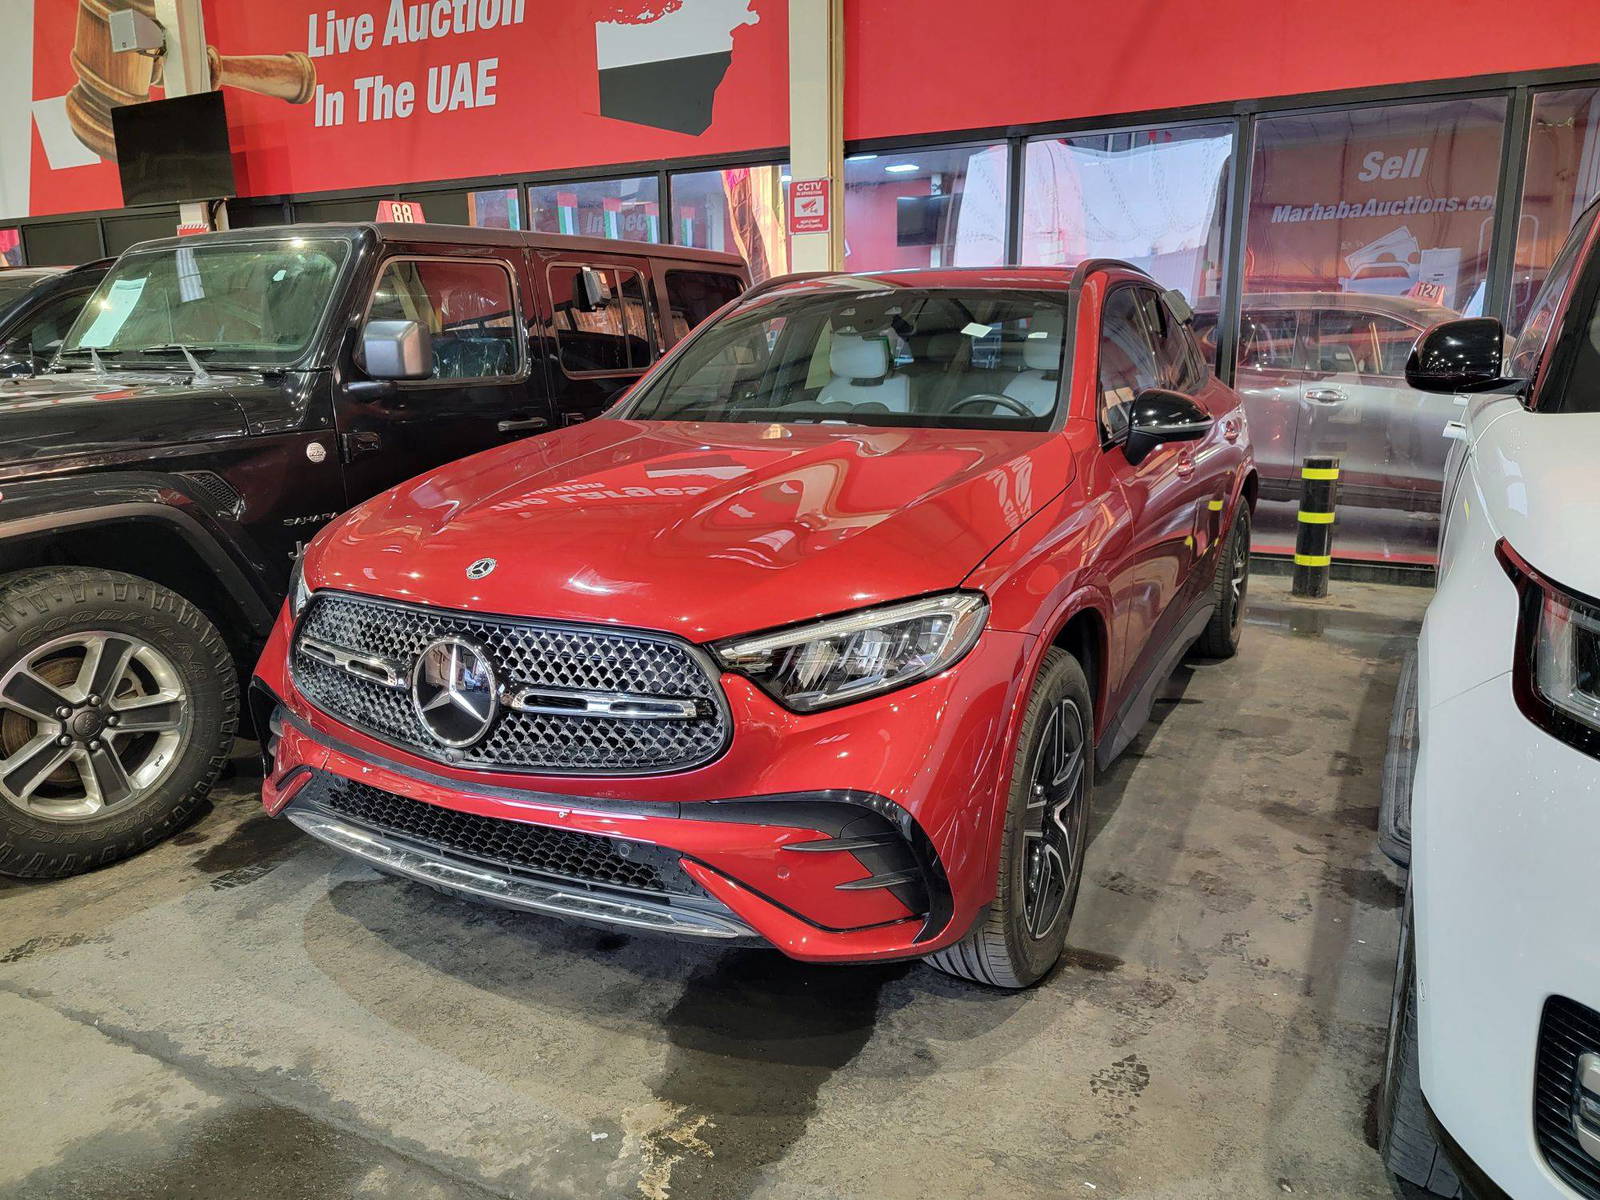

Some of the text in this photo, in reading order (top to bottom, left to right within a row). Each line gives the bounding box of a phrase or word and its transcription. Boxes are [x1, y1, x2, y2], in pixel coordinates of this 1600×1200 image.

[308, 0, 525, 57] Live Auction
[315, 57, 499, 127] In The UAE
[1358, 148, 1429, 182] Sell
[796, 182, 822, 191] CCTV
[392, 203, 413, 223] 88
[1271, 195, 1495, 223] MarhabaAuctions.co
[1418, 283, 1439, 298] 124
[283, 512, 338, 526] SAHARA
